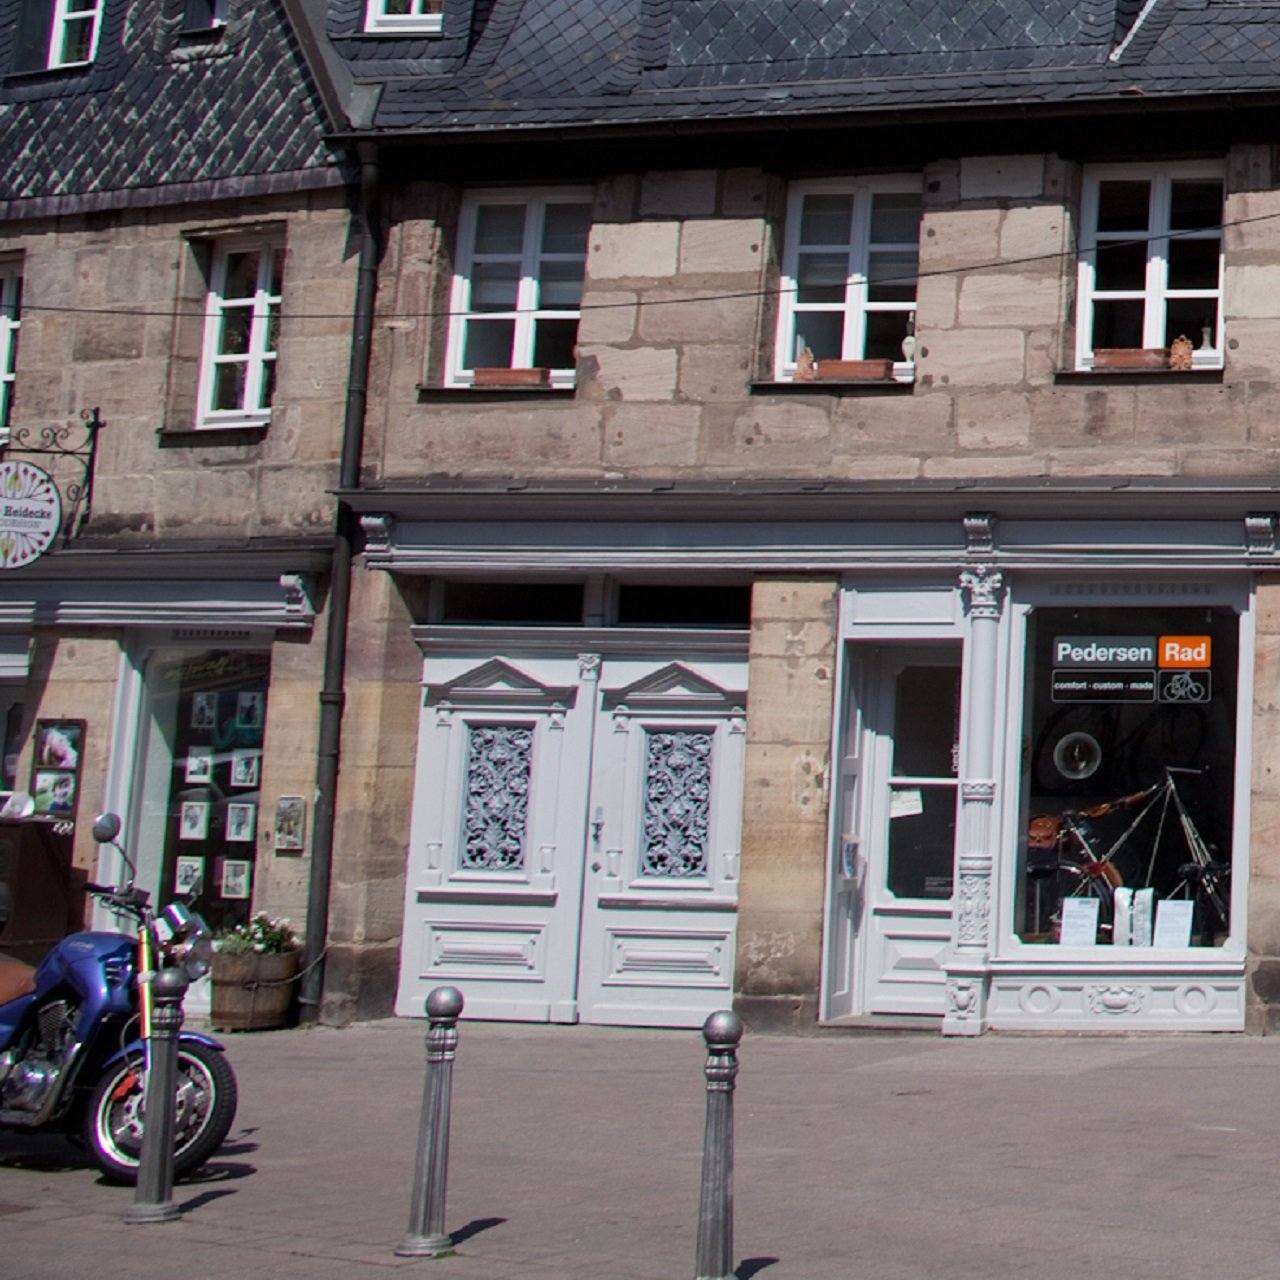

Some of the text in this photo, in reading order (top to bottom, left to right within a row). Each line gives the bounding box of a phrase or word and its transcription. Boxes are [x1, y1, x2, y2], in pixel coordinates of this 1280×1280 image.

[4, 505, 52, 519] Heidecke
[1057, 642, 1207, 662] Pedersen Rad
[1054, 681, 1154, 691] comfort custom made
